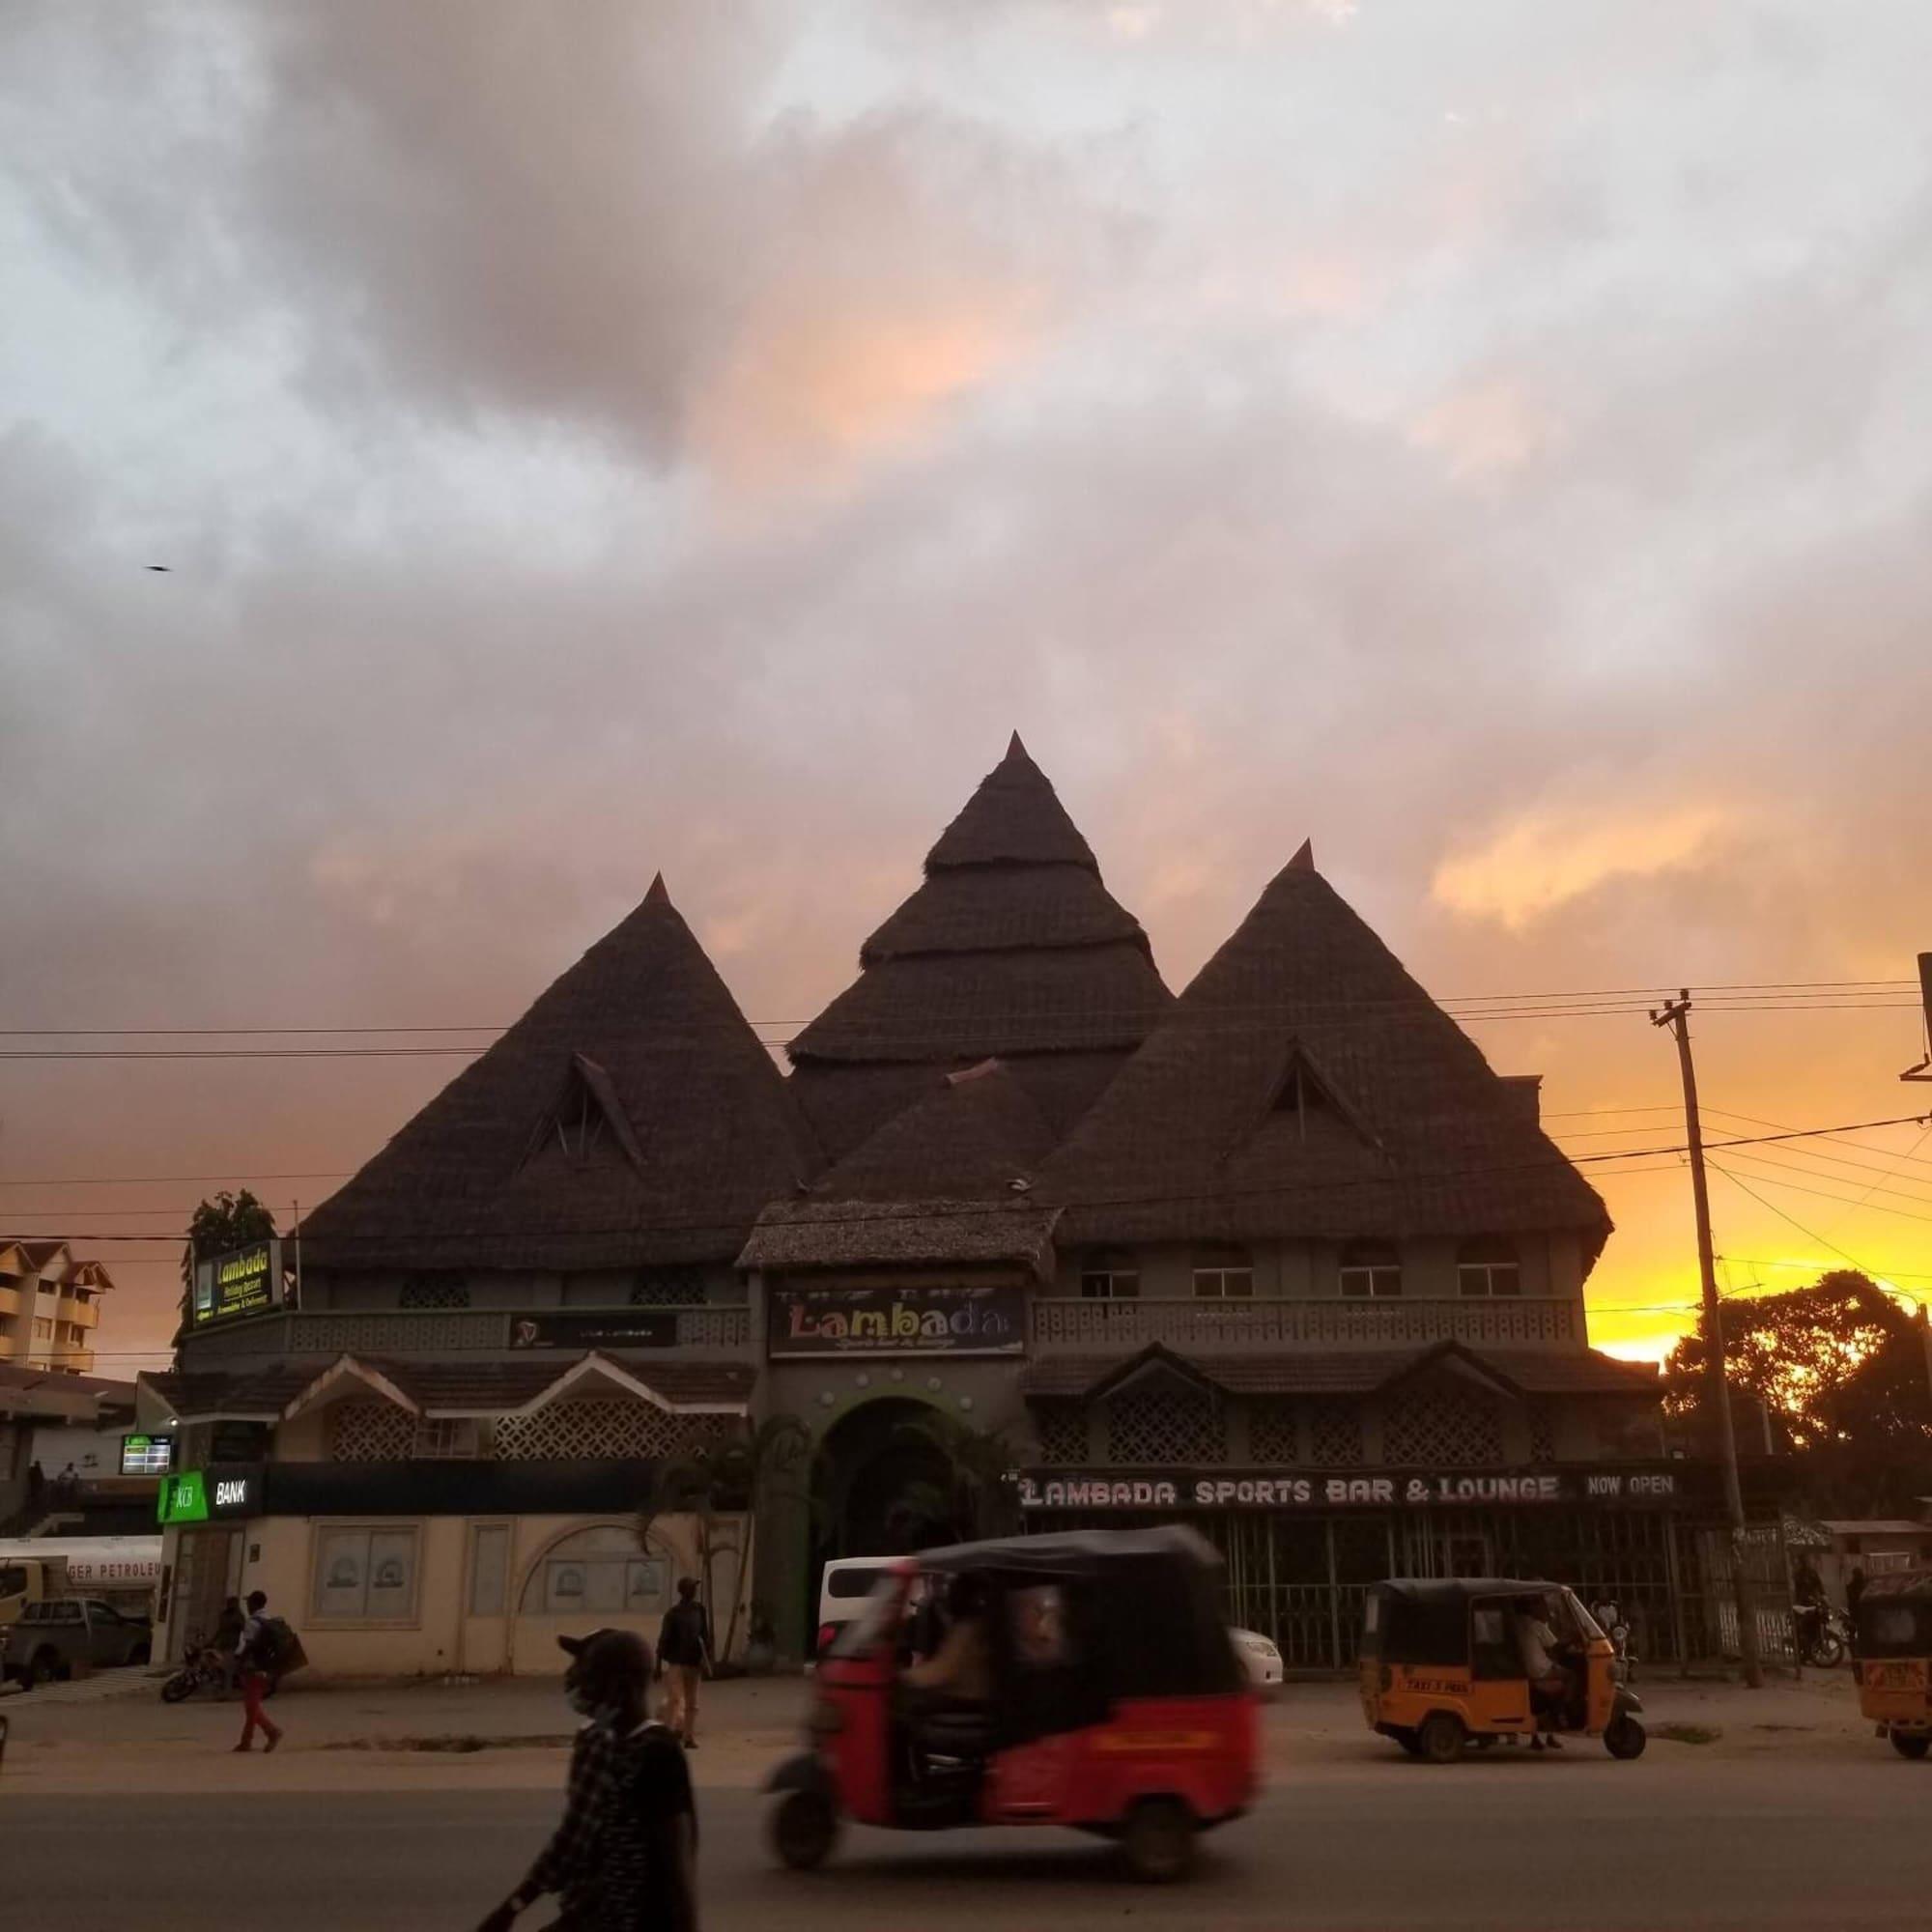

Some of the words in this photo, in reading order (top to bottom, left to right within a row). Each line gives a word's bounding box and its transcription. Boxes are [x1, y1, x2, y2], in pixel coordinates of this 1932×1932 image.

[217, 1247, 268, 1285] Lambada
[788, 1299, 1011, 1339] Lambada
[215, 1478, 247, 1506] BANK
[1017, 1478, 1176, 1506] LAMBADA
[1194, 1479, 1311, 1505] SPORTS
[1324, 1479, 1394, 1503] BAR
[1406, 1479, 1430, 1502] &
[1438, 1476, 1561, 1502] LOUNGE
[1587, 1476, 1621, 1495] NOW
[1630, 1475, 1673, 1494] OPEN
[69, 1564, 93, 1579] GER
[99, 1562, 161, 1577] PETROLEU
